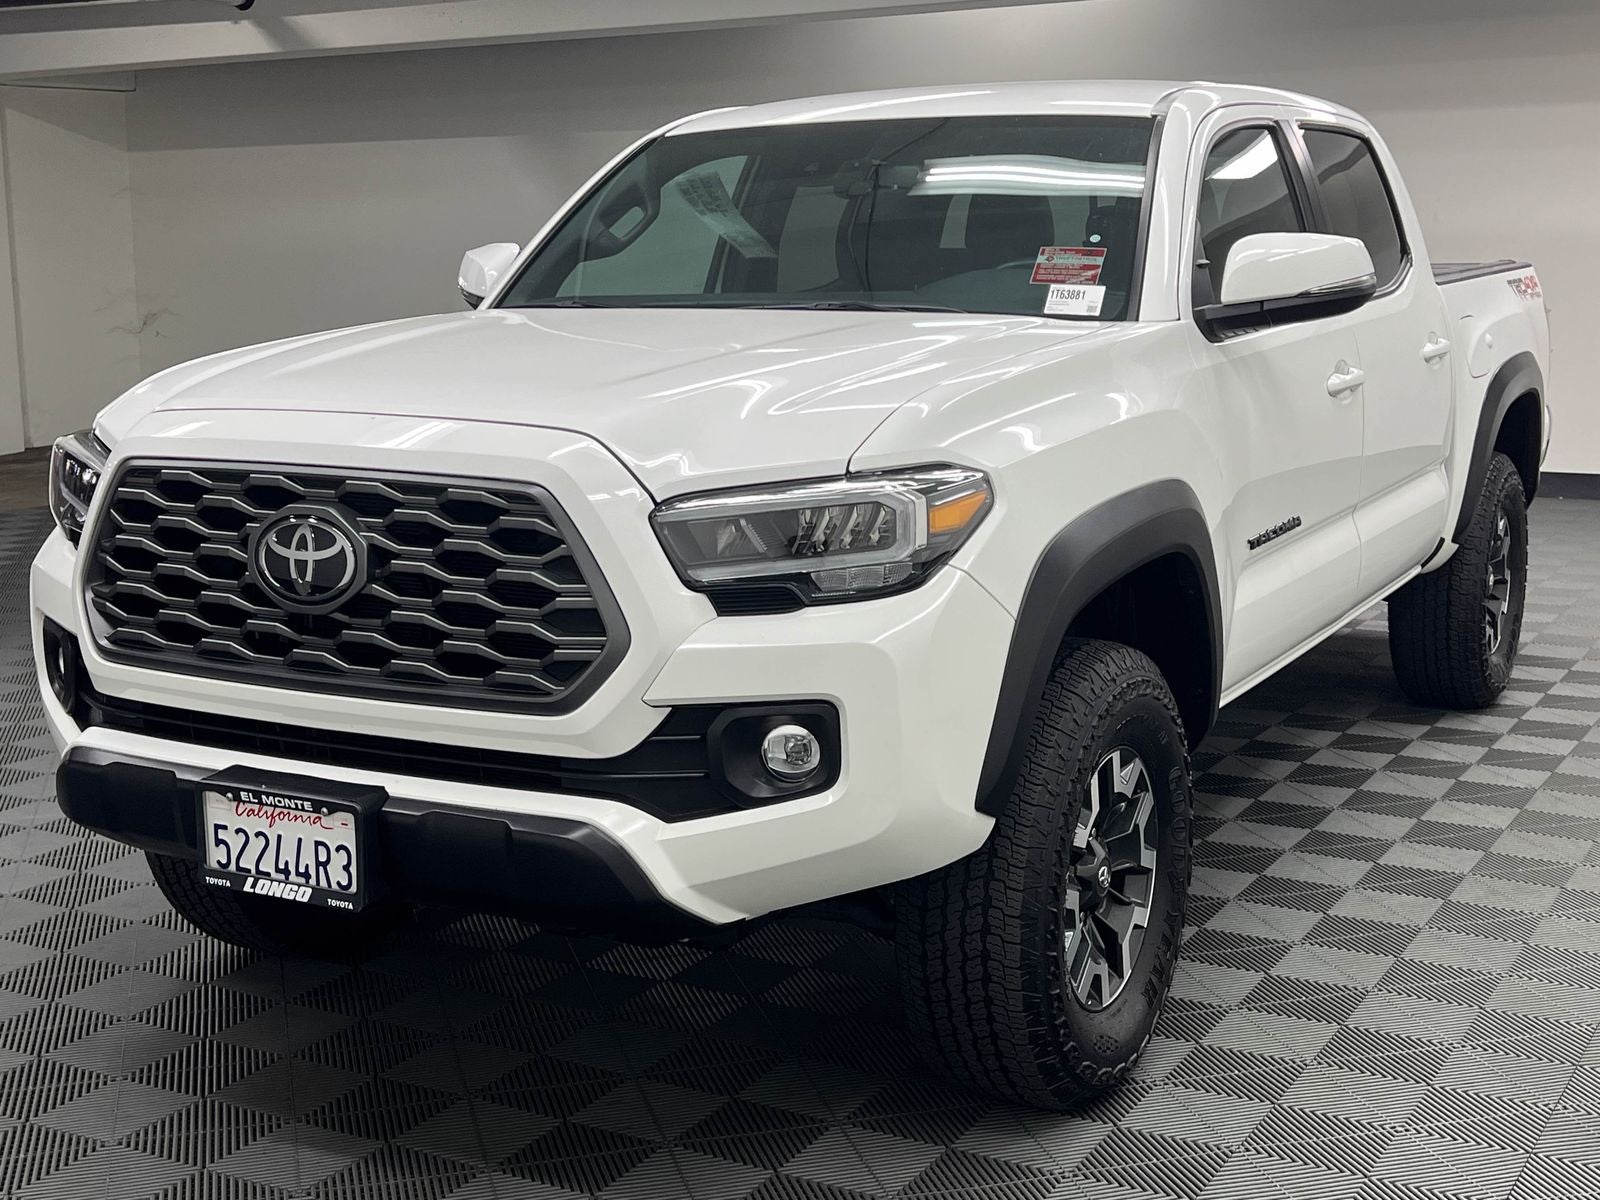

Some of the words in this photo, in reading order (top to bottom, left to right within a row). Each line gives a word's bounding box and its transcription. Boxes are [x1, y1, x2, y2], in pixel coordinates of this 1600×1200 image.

[1050, 289, 1086, 300] 1T63881
[1247, 515, 1302, 550] TACOMA
[239, 791, 258, 803] EL
[261, 794, 313, 811] MONTE
[235, 801, 334, 829] California
[213, 823, 353, 892] 52244R3
[205, 876, 231, 888] TOYOTA
[243, 876, 313, 903] LONGO
[327, 898, 354, 910] TOYOTA
